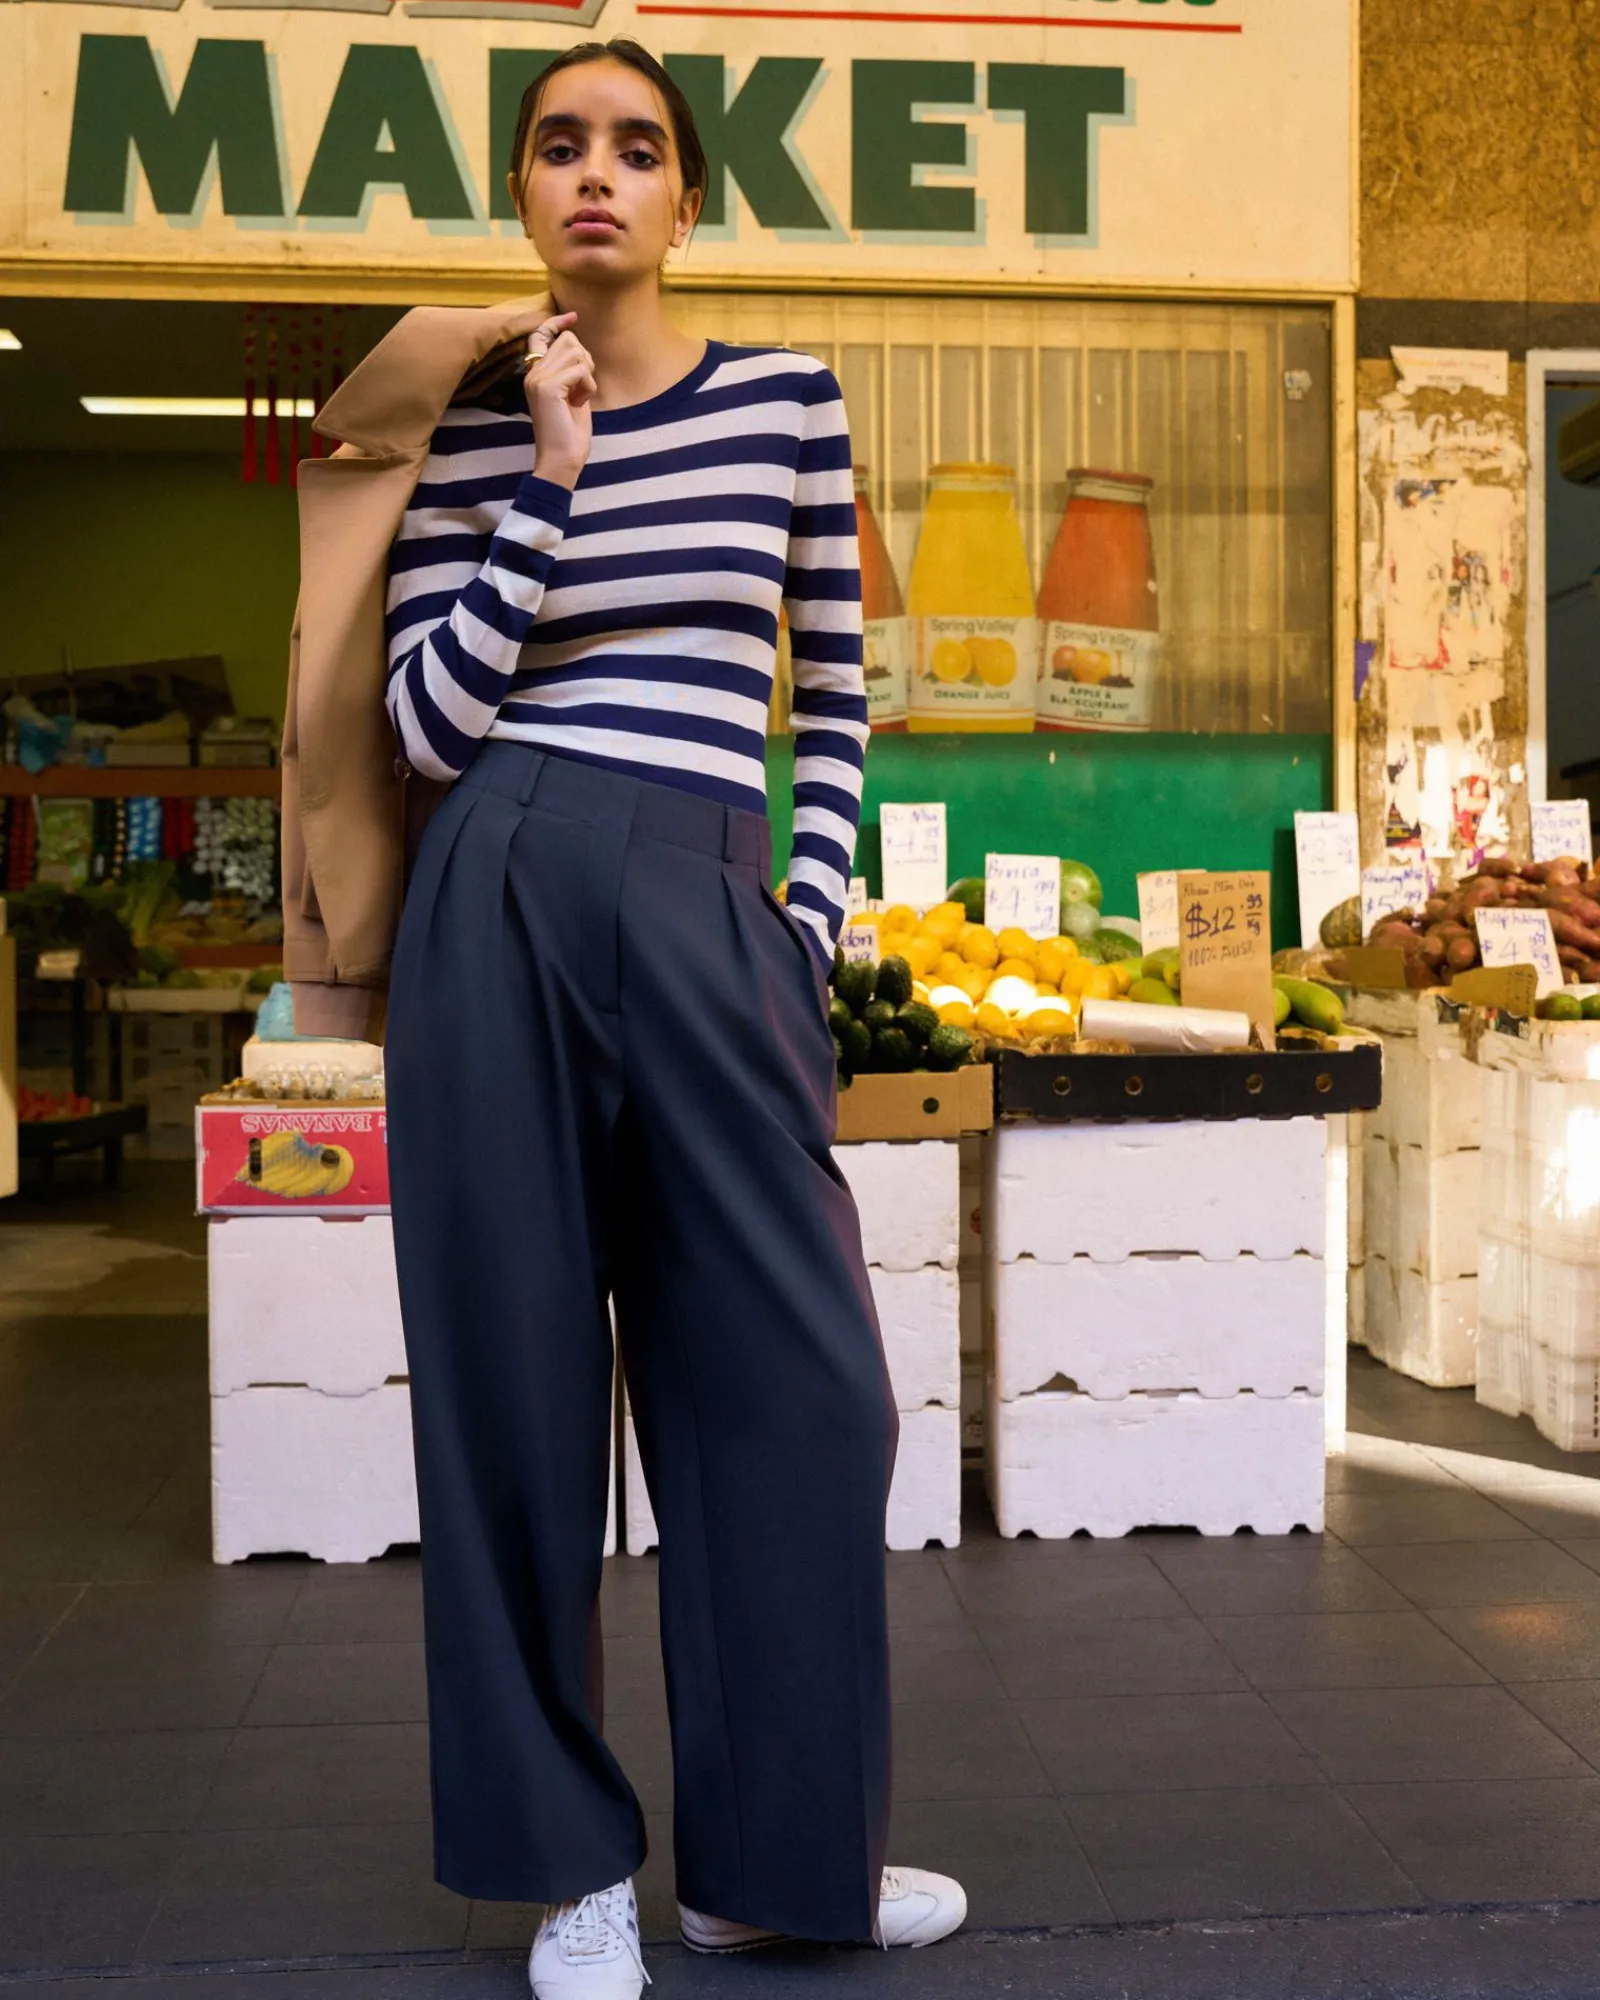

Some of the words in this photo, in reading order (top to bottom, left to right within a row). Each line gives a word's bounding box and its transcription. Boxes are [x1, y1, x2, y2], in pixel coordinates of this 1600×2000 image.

[933, 689, 979, 700] ORANGE
[983, 690, 1011, 700] JUICE
[1069, 686, 1101, 699] APPLE
[1050, 694, 1130, 710] BLACKCURRANT
[1074, 708, 1103, 720] JUICE
[1187, 946, 1217, 968] 100%
[241, 1113, 372, 1133] BANANAS
